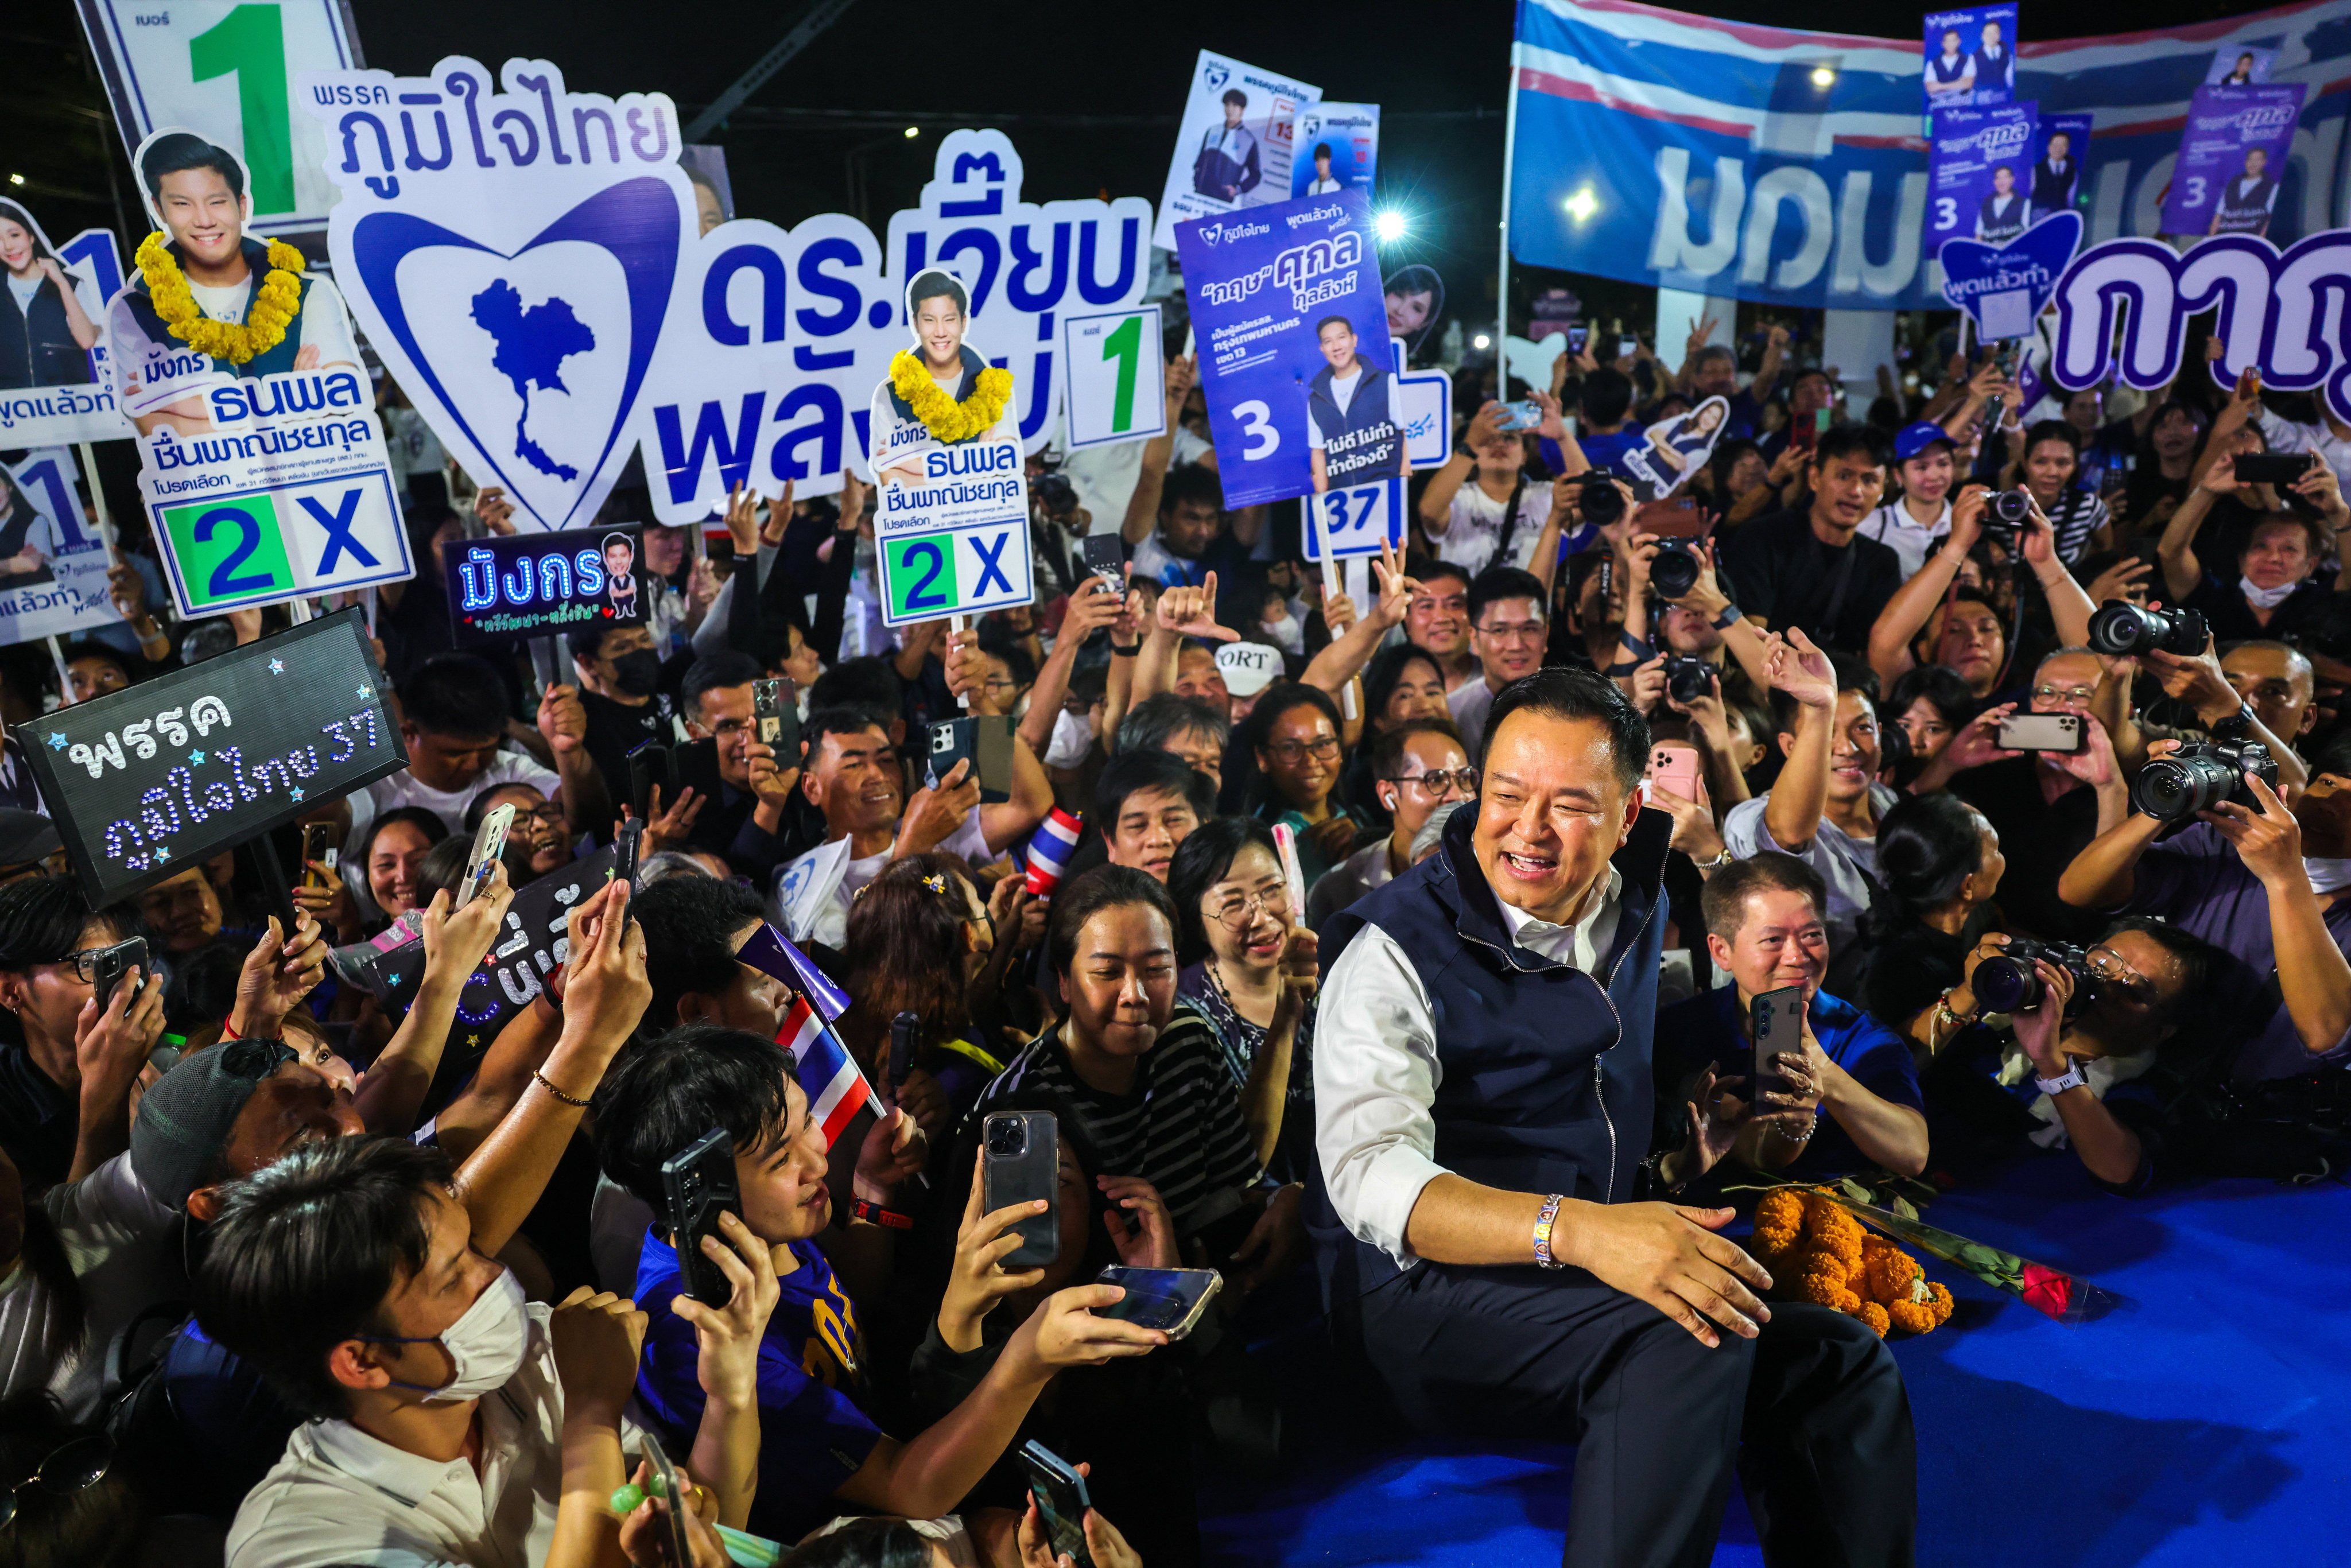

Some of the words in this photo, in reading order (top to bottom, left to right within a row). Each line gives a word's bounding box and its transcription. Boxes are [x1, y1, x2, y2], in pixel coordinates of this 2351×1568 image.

[135, 11, 170, 26] เบอร์
[189, 3, 296, 214] 1
[313, 84, 390, 106] พรรค
[339, 72, 670, 200] ภูมิใจไทย
[2182, 176, 2207, 208] 3
[1286, 203, 1344, 230] พูดแล้วทำ
[1934, 197, 1958, 231] 3
[701, 150, 1139, 346] ดร.เจี๊ยบ
[1224, 223, 1270, 244] ภูมิใจไทย
[61, 233, 123, 309] 1
[1293, 270, 1359, 313] กุลสิงห์
[1213, 316, 1301, 352] กรุงเทพมหานคร
[144, 350, 205, 385] มังกร
[1233, 346, 1247, 359] 13
[1102, 316, 1142, 433] 1
[211, 372, 362, 423] ธนพล
[152, 419, 372, 471] ชื่นพาณิชยกุล
[890, 425, 927, 448] มังกร
[1231, 399, 1281, 461] 3
[1354, 424, 1395, 447] ไม่ทำ
[926, 444, 1017, 478] ธนพล
[153, 473, 231, 496] โปรดเลือก
[887, 480, 1019, 512] ชื่นพาณิชยกุล
[18, 460, 85, 546] 1
[1325, 487, 1380, 534] 37
[883, 516, 930, 530] โปรดเลือก
[193, 507, 276, 597] 2
[295, 488, 382, 576] X
[459, 547, 604, 611] มังกร
[902, 542, 946, 610] 2
[968, 532, 1014, 599] X
[68, 694, 232, 779] พรรค
[2218, 746, 2238, 757] Canon
[105, 746, 320, 871] ภูมิใจไทย
[321, 708, 376, 763] 37
[2045, 948, 2062, 959] Canon
